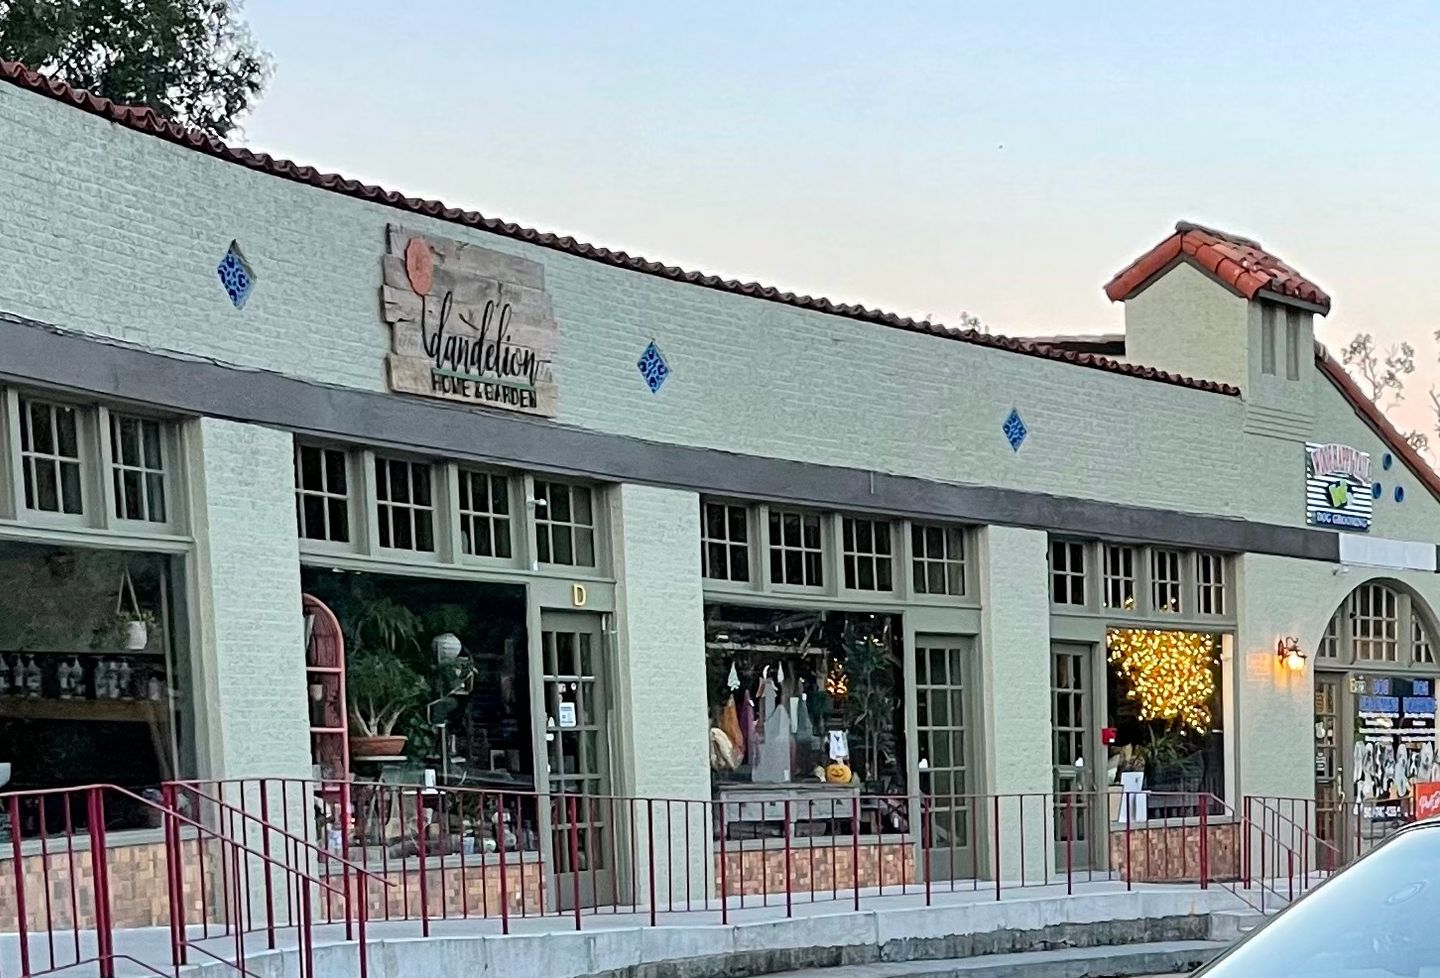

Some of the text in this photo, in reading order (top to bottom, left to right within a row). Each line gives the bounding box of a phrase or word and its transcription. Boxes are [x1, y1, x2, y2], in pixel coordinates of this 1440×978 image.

[425, 291, 538, 386] dandelion
[485, 384, 536, 408] GARDEN
[573, 584, 586, 606] D
